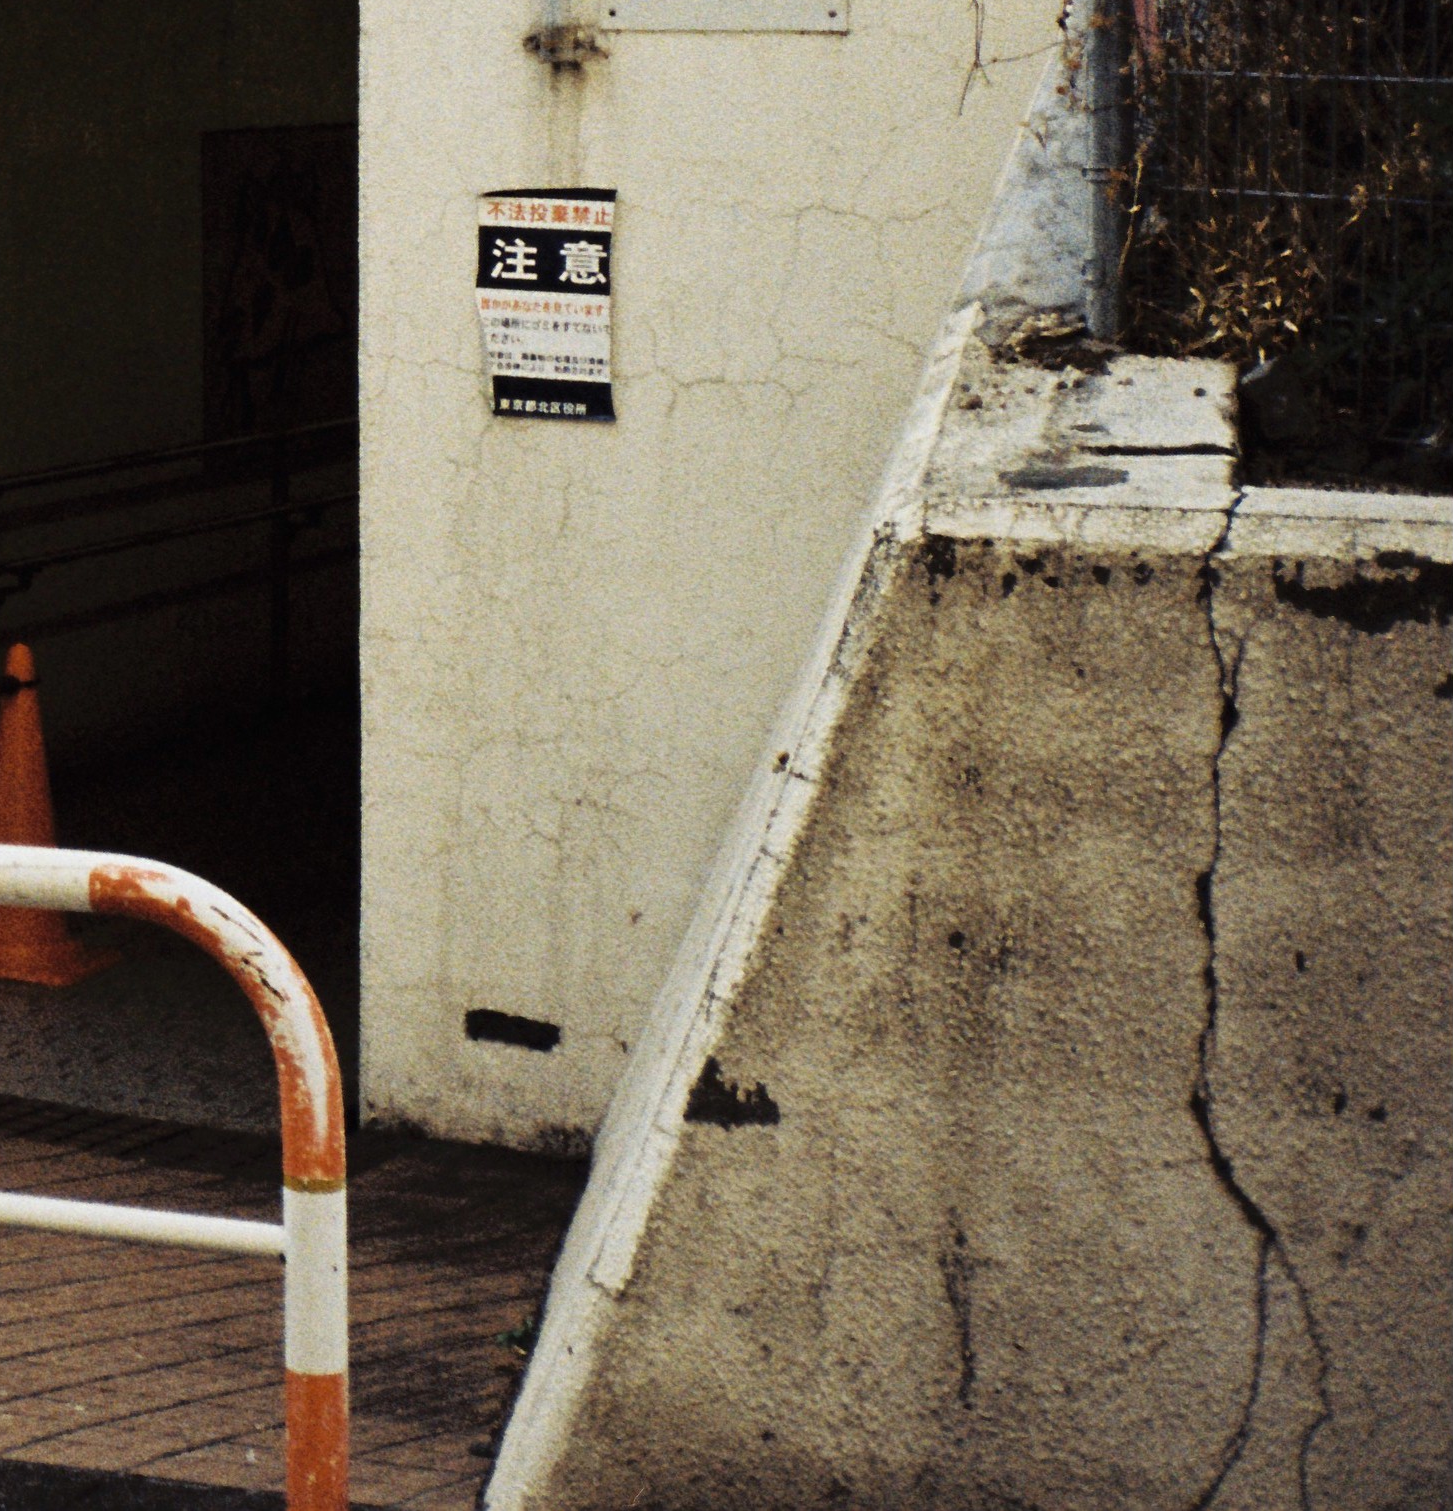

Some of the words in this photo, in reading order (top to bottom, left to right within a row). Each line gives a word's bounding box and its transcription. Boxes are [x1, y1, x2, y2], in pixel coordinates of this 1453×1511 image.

[487, 201, 613, 226] 不法投棄禁止
[491, 238, 608, 285] 注意
